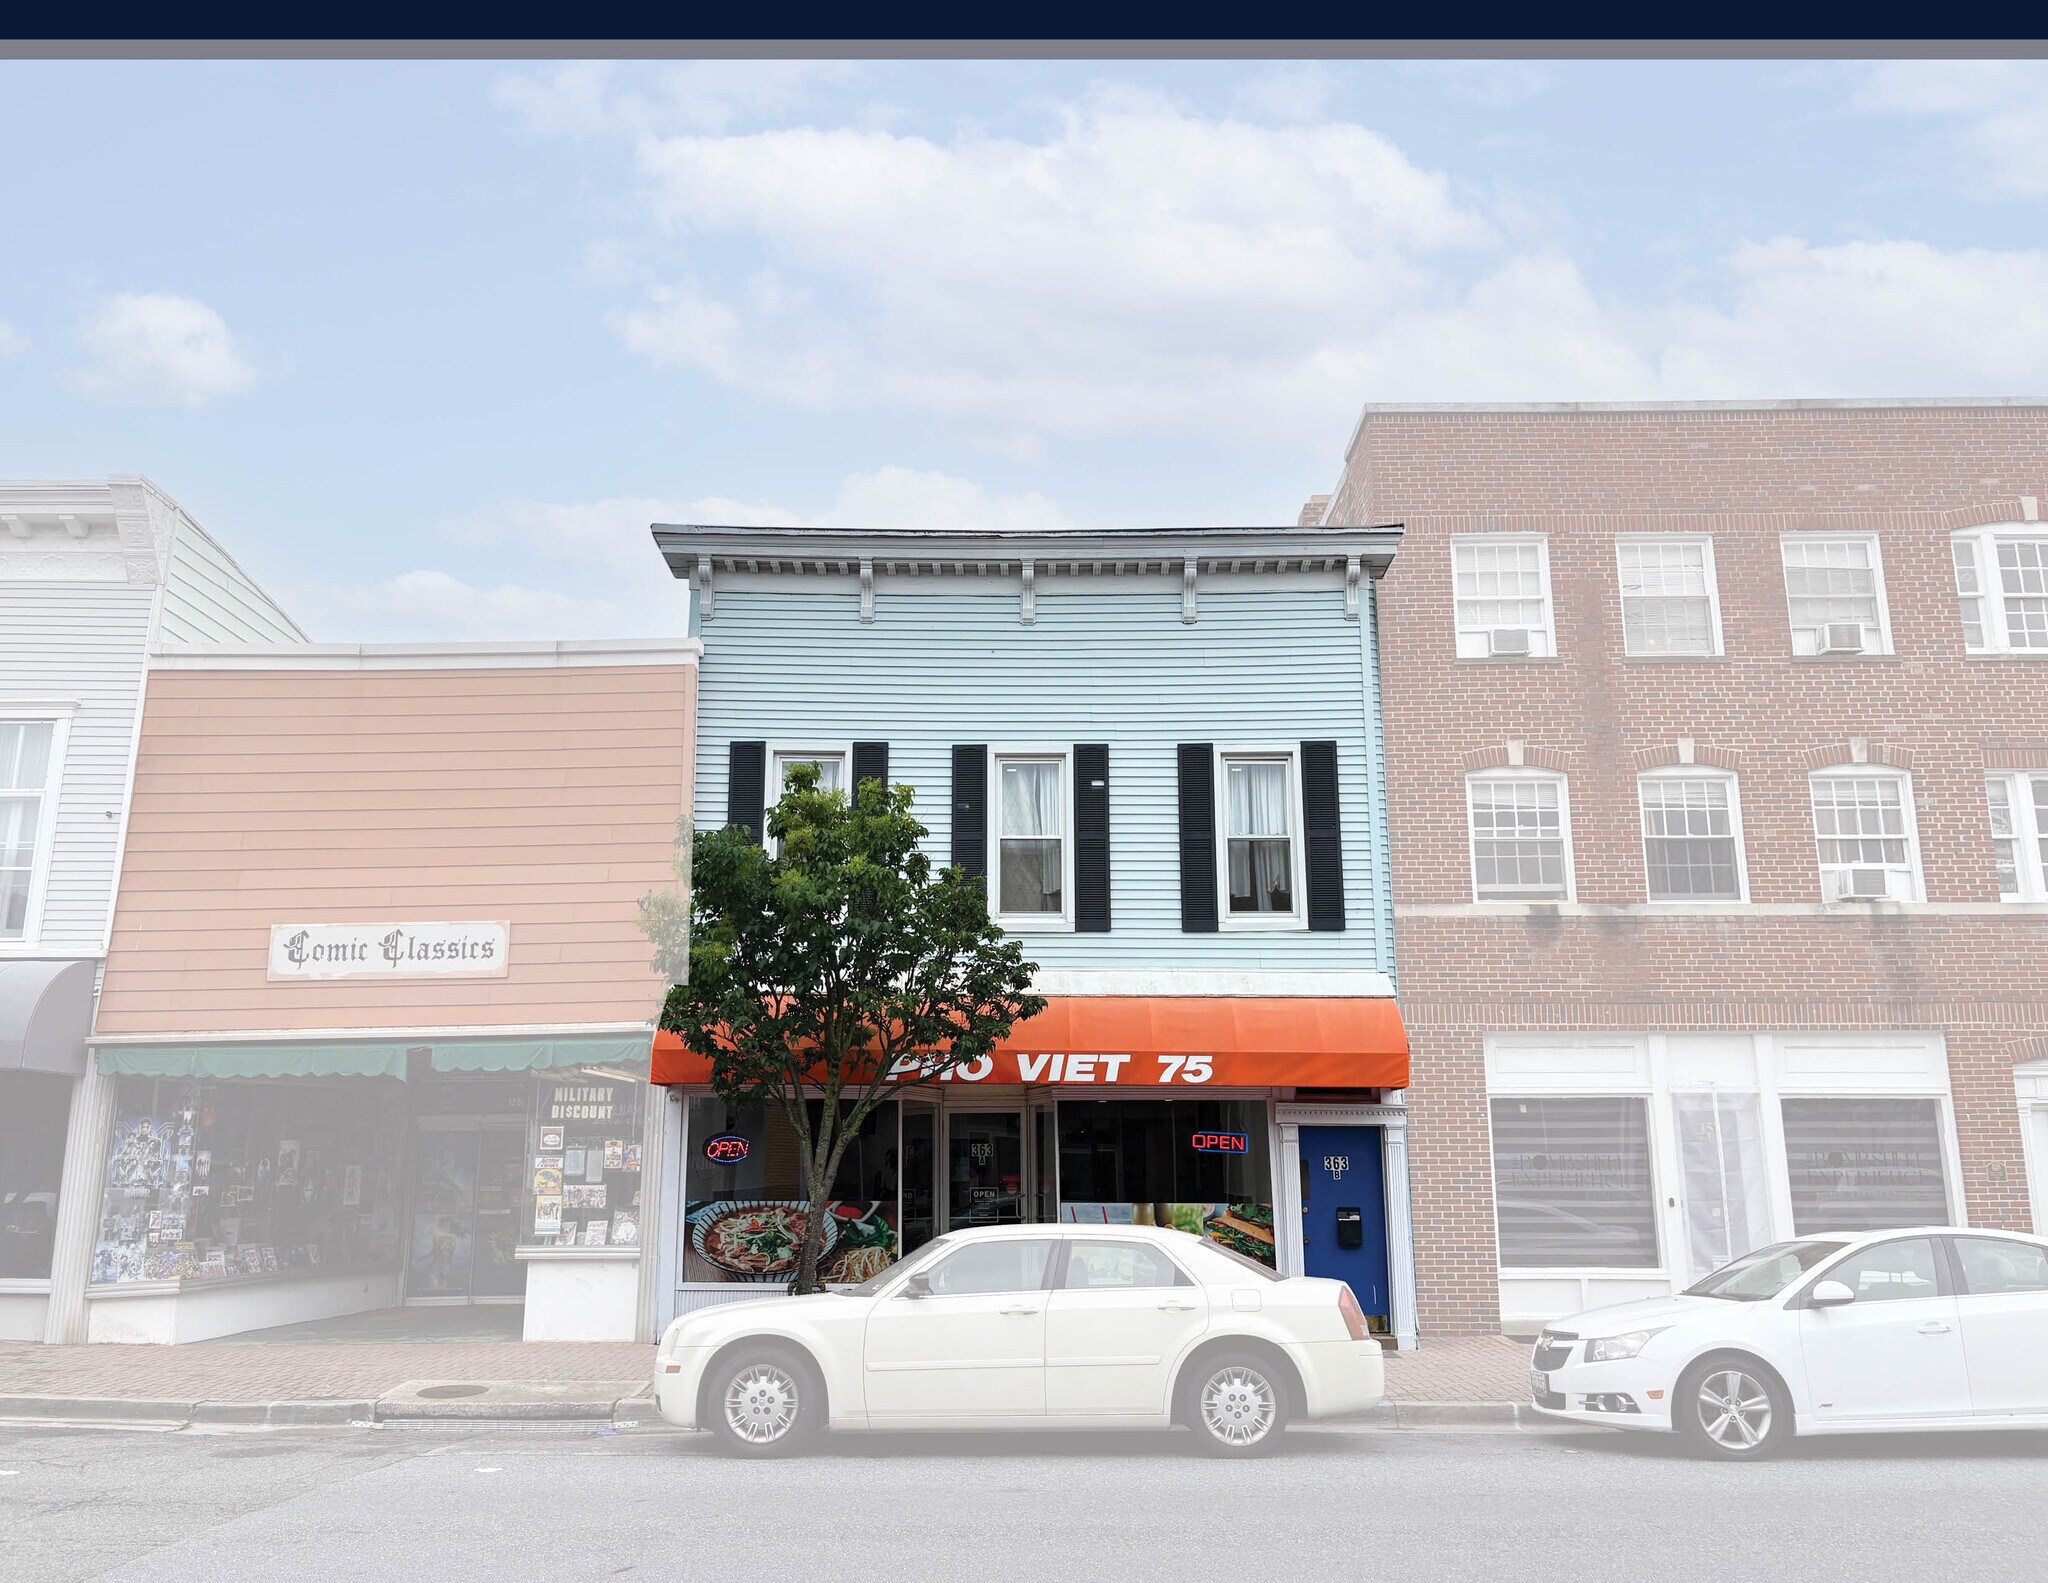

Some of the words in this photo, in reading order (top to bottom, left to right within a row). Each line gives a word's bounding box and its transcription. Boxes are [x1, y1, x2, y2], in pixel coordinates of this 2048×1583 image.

[283, 929, 368, 969] Comic
[378, 928, 496, 969] Classics
[885, 1053, 994, 1081] PHO
[1017, 1054, 1131, 1082] VIET
[1157, 1055, 1214, 1083] 75
[554, 1087, 614, 1102] MILITARY
[706, 1140, 750, 1158] OPEN
[972, 1144, 993, 1156] 363
[1192, 1134, 1245, 1151] OPEN
[1325, 1157, 1348, 1170] 363
[1334, 1171, 1340, 1179] B
[973, 1190, 995, 1198] OPEN
